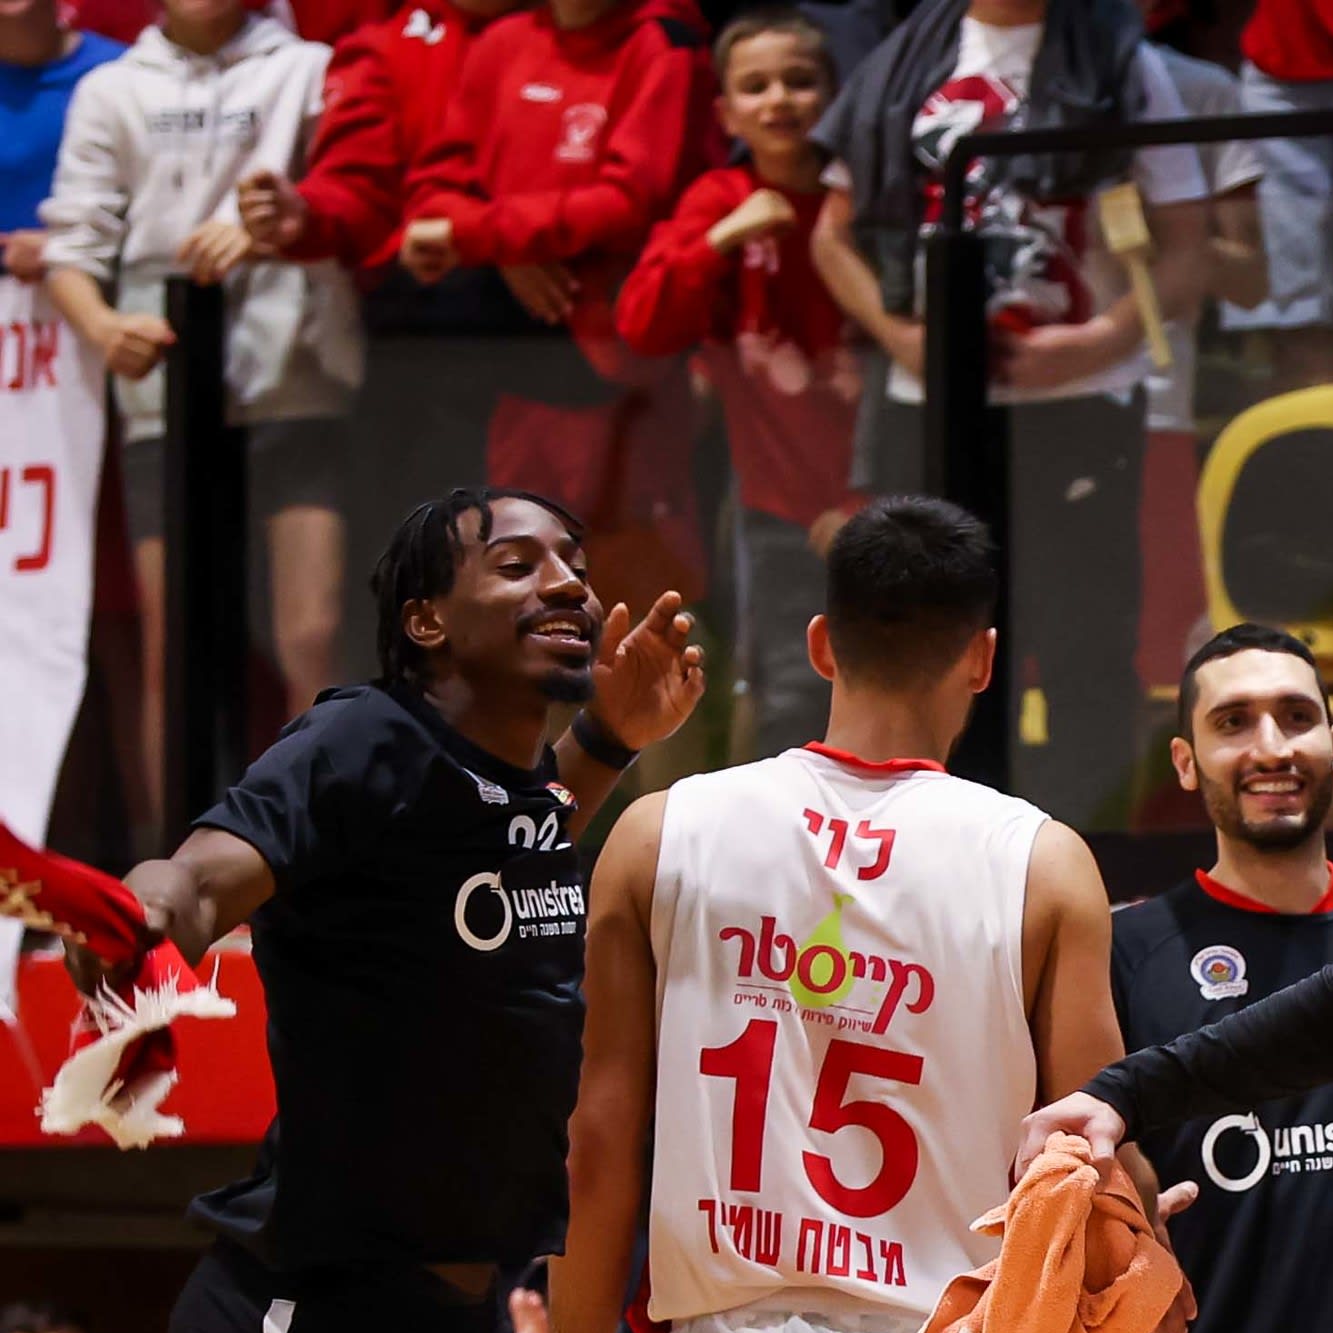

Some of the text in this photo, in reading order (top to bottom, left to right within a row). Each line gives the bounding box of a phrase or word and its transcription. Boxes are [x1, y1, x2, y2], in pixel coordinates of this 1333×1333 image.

[803, 808, 896, 881] לוי
[719, 916, 935, 1035] מייסטר
[733, 992, 767, 1008] טריים
[838, 1015, 872, 1033] שיווק
[699, 1019, 924, 1218] 15
[1272, 1160, 1301, 1176] חיים
[698, 1199, 908, 1286] מבטח שמיר
